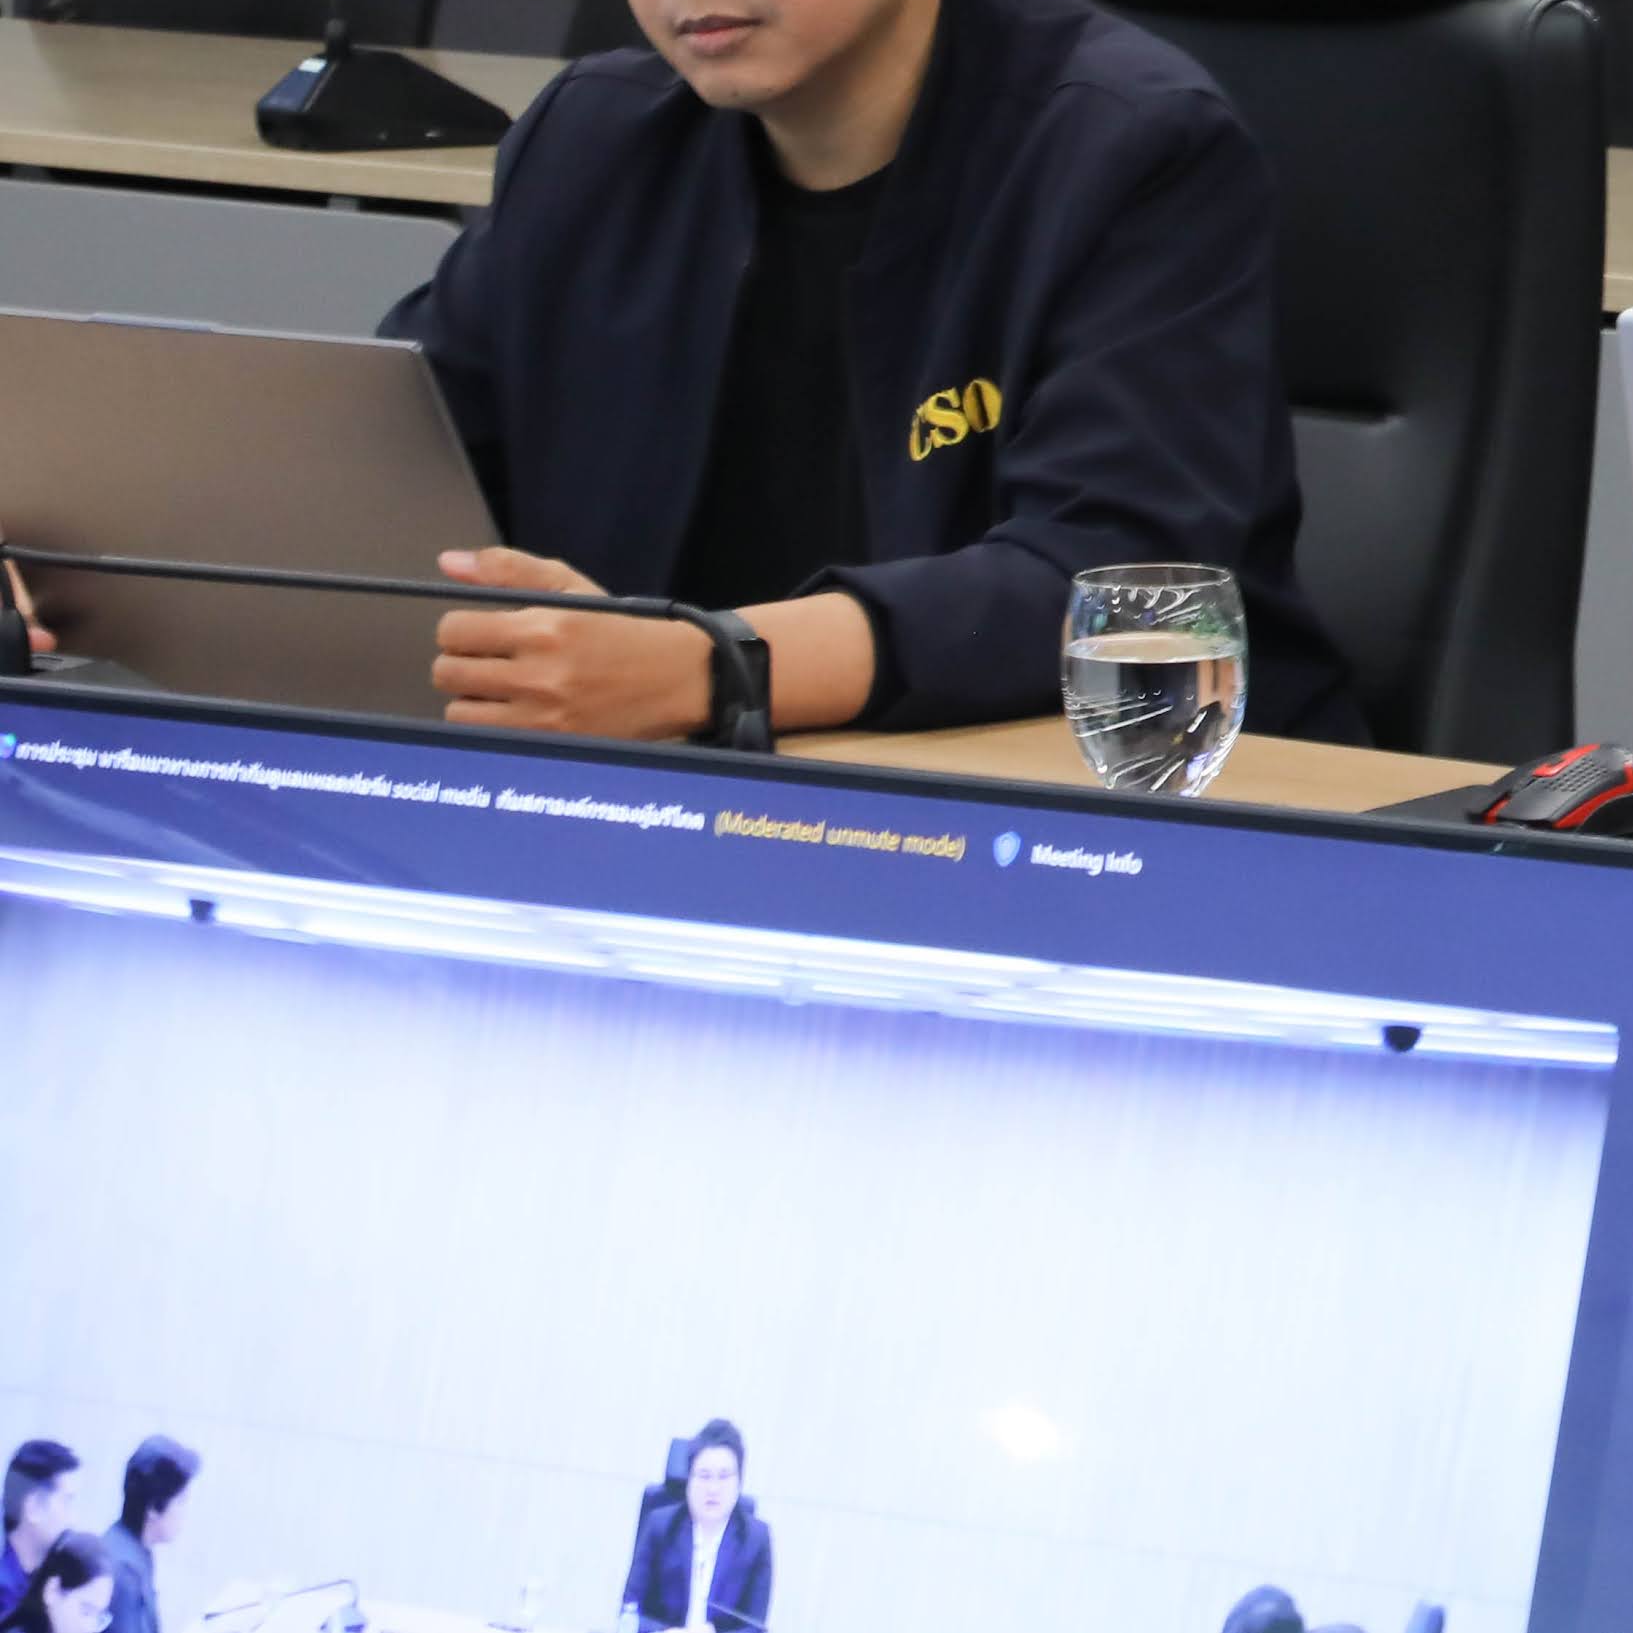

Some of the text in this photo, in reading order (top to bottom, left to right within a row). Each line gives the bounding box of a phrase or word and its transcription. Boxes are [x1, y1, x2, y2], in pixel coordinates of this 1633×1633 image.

[714, 810, 825, 844] (Moderated
[824, 825, 900, 852] unmute
[901, 832, 965, 861] mode)
[1031, 843, 1143, 877] Meeting Info
